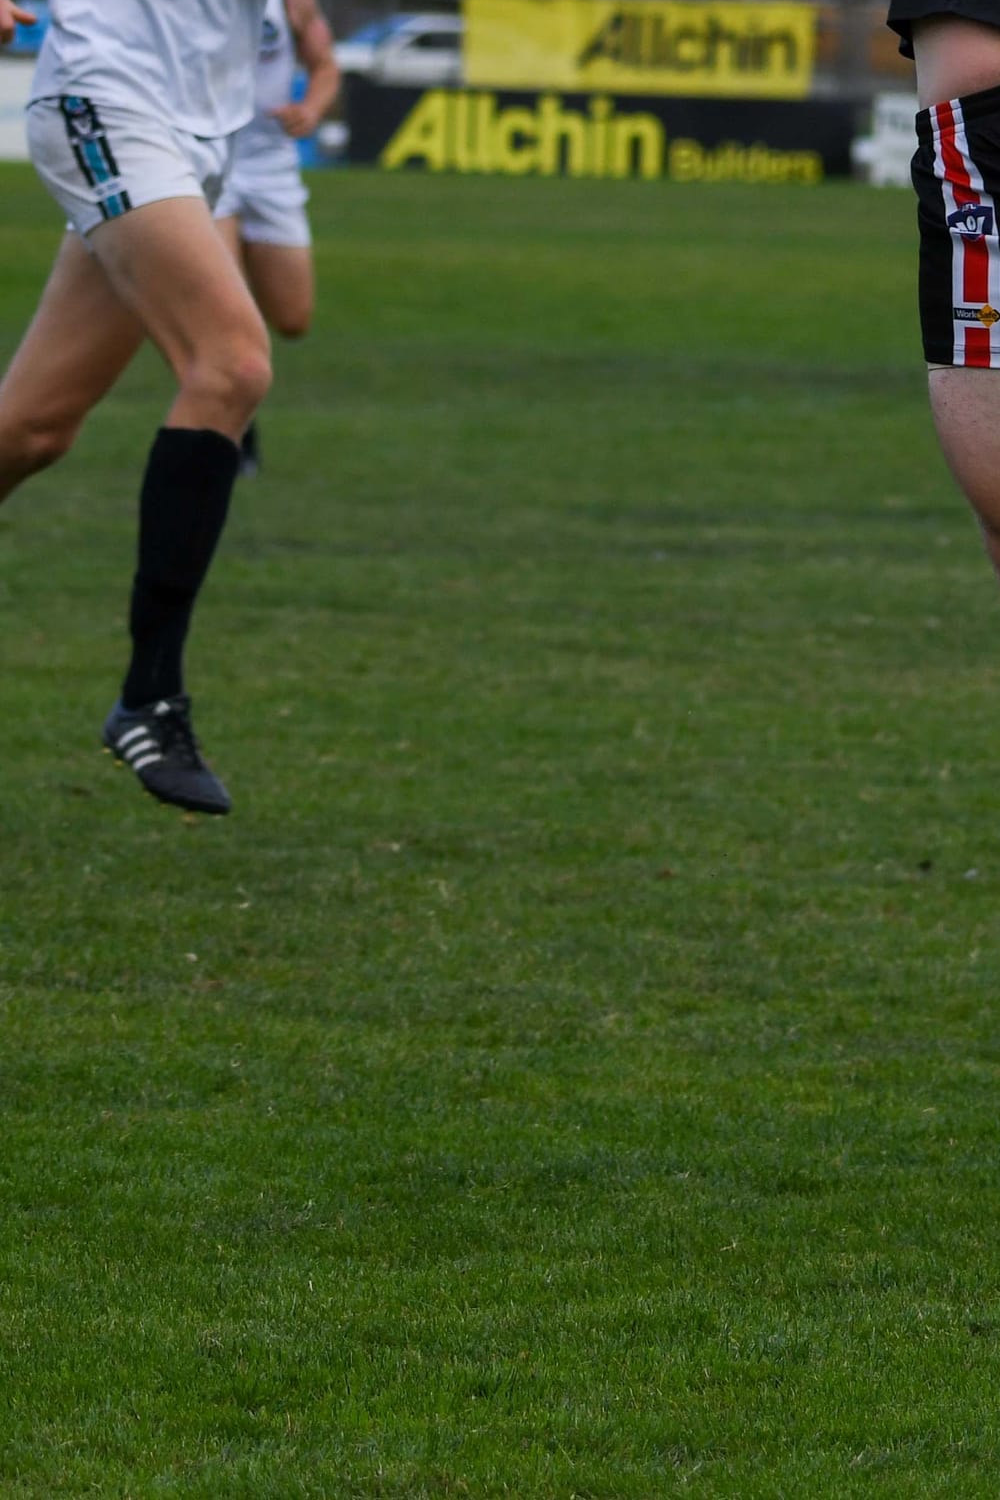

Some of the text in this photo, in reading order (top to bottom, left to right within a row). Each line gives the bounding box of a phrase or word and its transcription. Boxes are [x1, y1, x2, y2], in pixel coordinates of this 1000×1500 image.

[579, 12, 797, 73] Allchin
[380, 89, 823, 183] Allchin Builders
